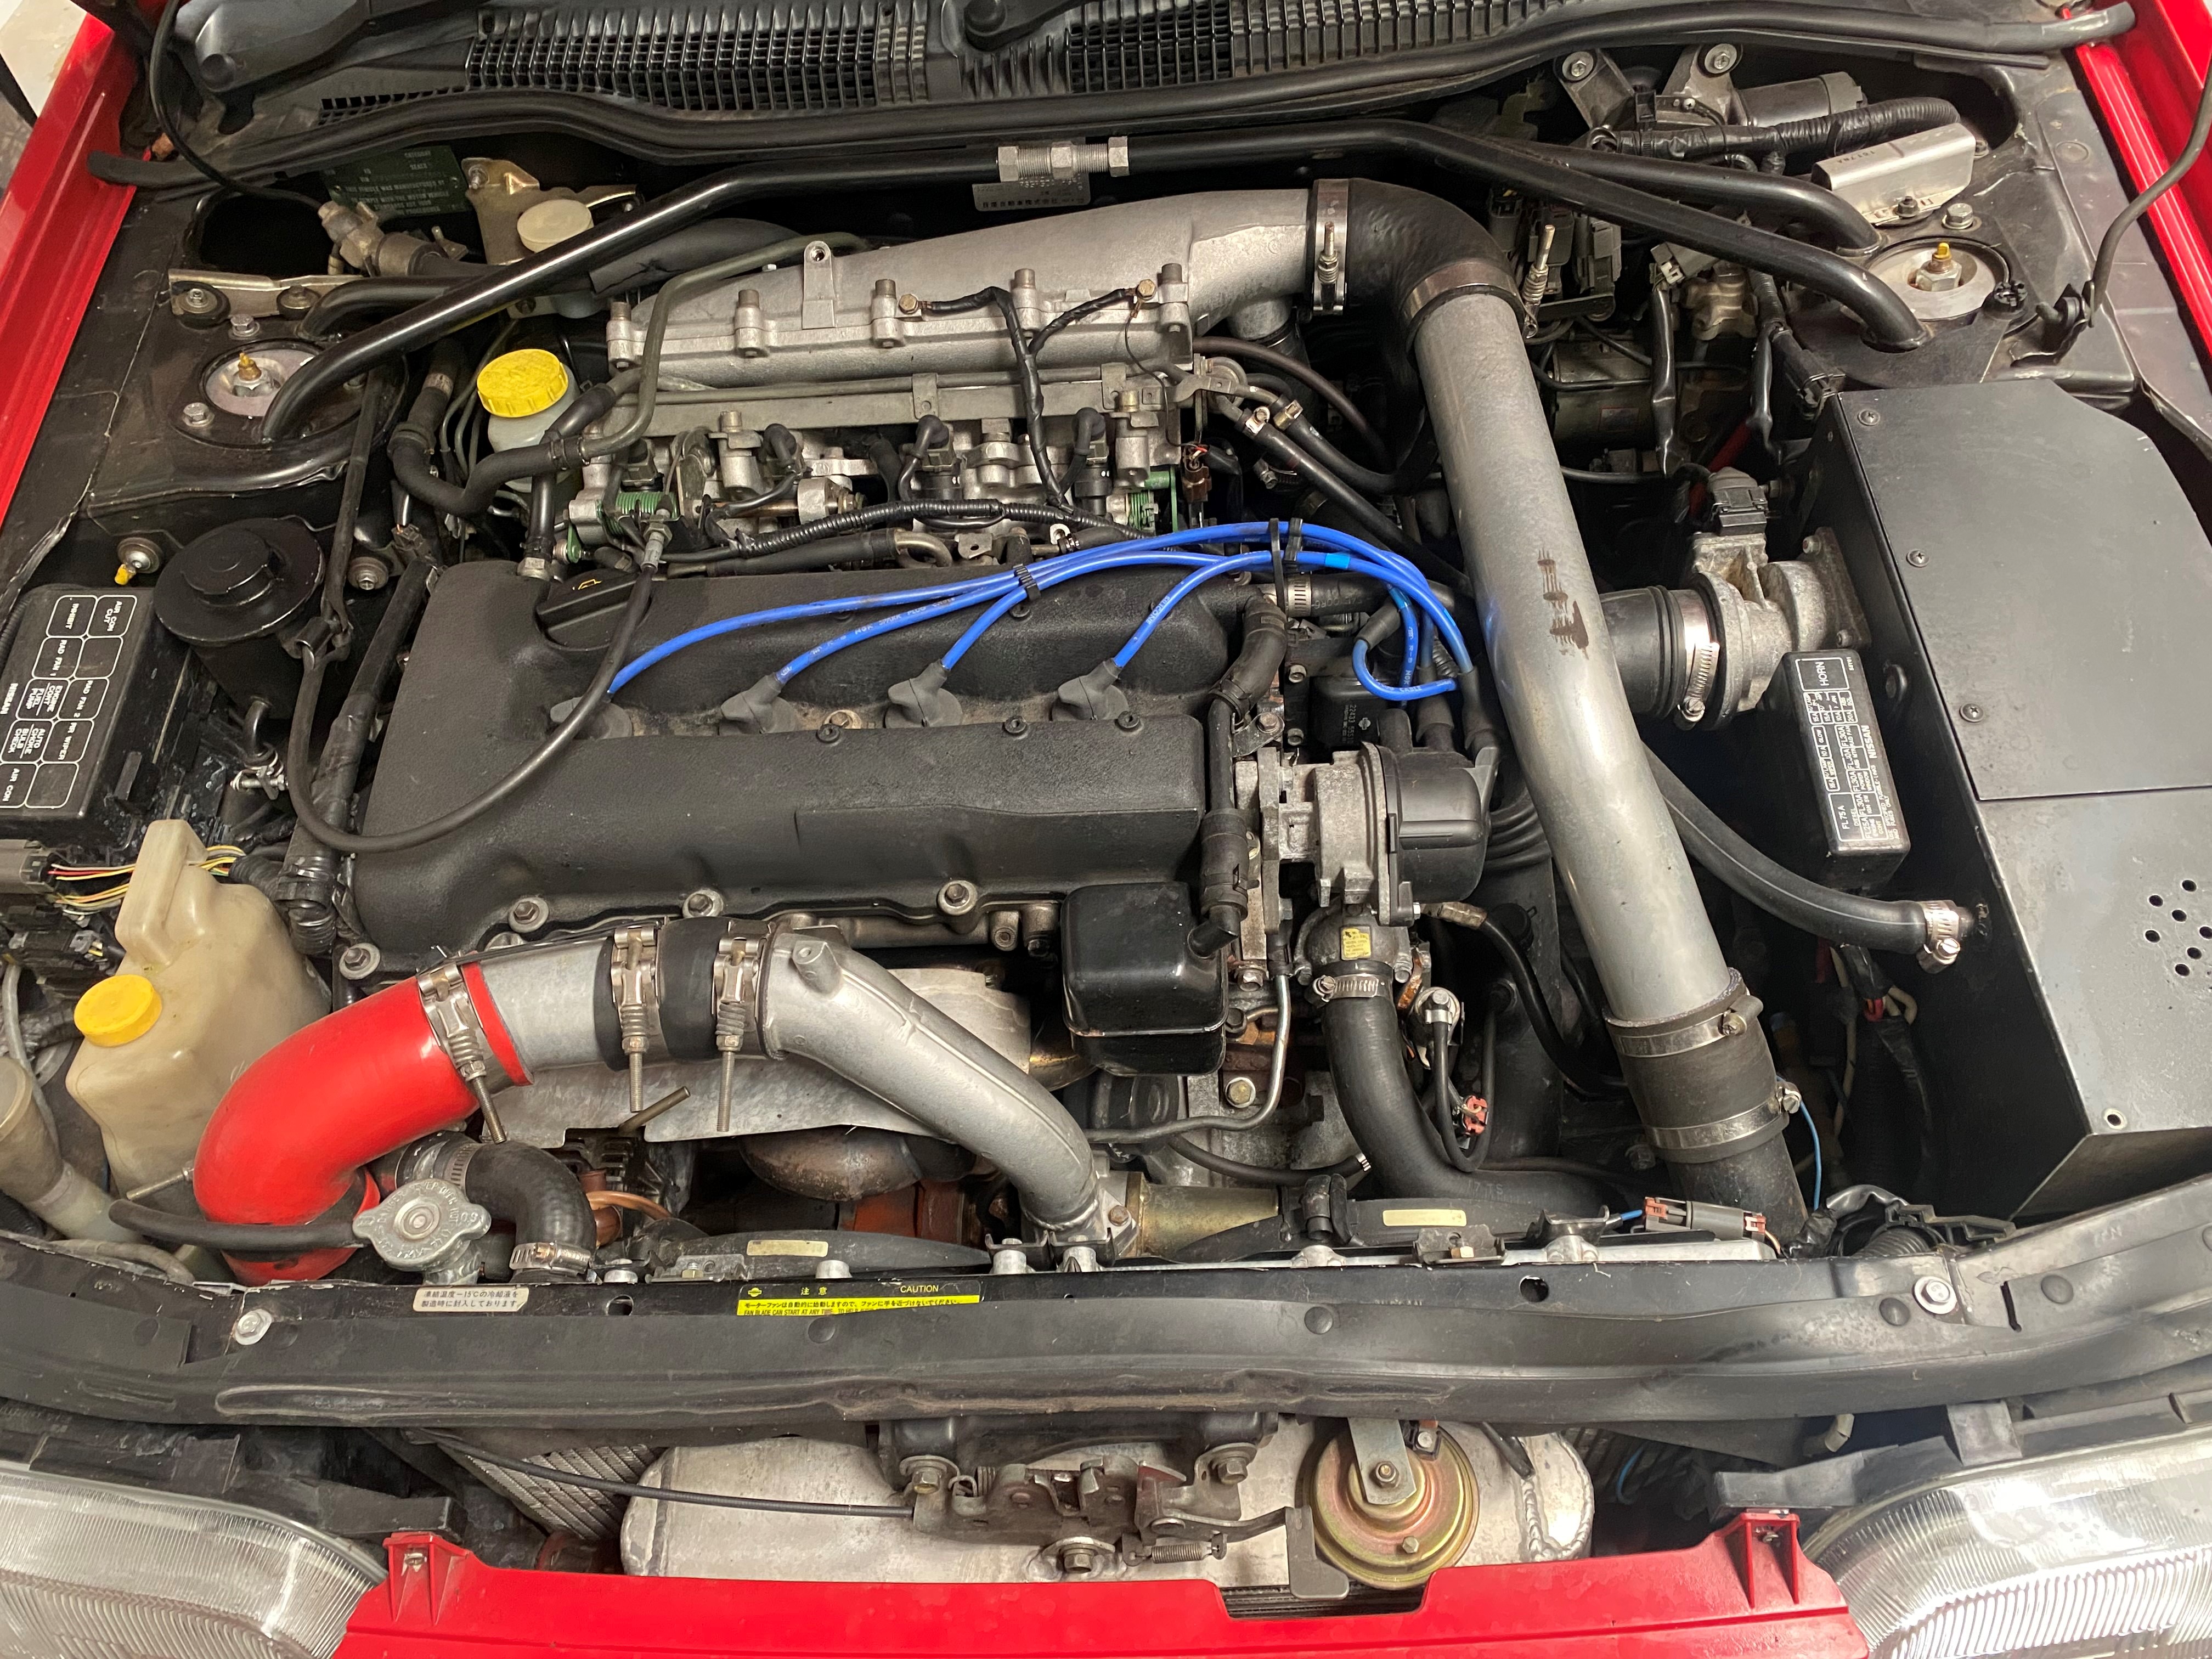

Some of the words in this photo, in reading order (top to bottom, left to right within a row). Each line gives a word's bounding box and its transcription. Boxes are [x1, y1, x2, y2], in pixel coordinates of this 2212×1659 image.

[65, 603, 80, 629] INHIBIT
[104, 608, 113, 623] CUT
[113, 601, 122, 613] AIR
[1146, 595, 1170, 625] SILICONE
[107, 616, 117, 631] CON
[58, 640, 67, 654] RAD
[52, 657, 63, 670] FAN
[1815, 662, 1830, 686] HORN
[43, 685, 56, 706] CONT
[83, 680, 93, 694] RAD
[0, 683, 18, 715] NISSAN
[26, 688, 38, 709] PUMP
[32, 688, 45, 708] FUEL
[47, 685, 63, 712] ENGINE
[76, 697, 87, 710] FAN
[1348, 704, 1356, 723] 22433
[67, 723, 77, 733] RR
[1837, 726, 1849, 747] FL30A
[8, 728, 22, 754] CHECK
[16, 728, 29, 749] BULB
[24, 728, 39, 754] CHOKE
[33, 729, 46, 749] AUTO
[58, 736, 72, 760] WIPER
[1861, 725, 1877, 759] NISSAN
[9, 768, 20, 782] AIR
[1828, 779, 1836, 789] 15A
[1849, 771, 1861, 792] FL30A
[1857, 772, 1866, 790] POWER
[1863, 771, 1872, 791] WINDOW
[2, 785, 13, 802] CON
[1863, 794, 1870, 803] SW
[1855, 794, 1866, 815] FL30A
[1850, 808, 1859, 826] DIESEL
[1861, 817, 1872, 839] FL25A
[900, 1285, 939, 1293] CAUTION
